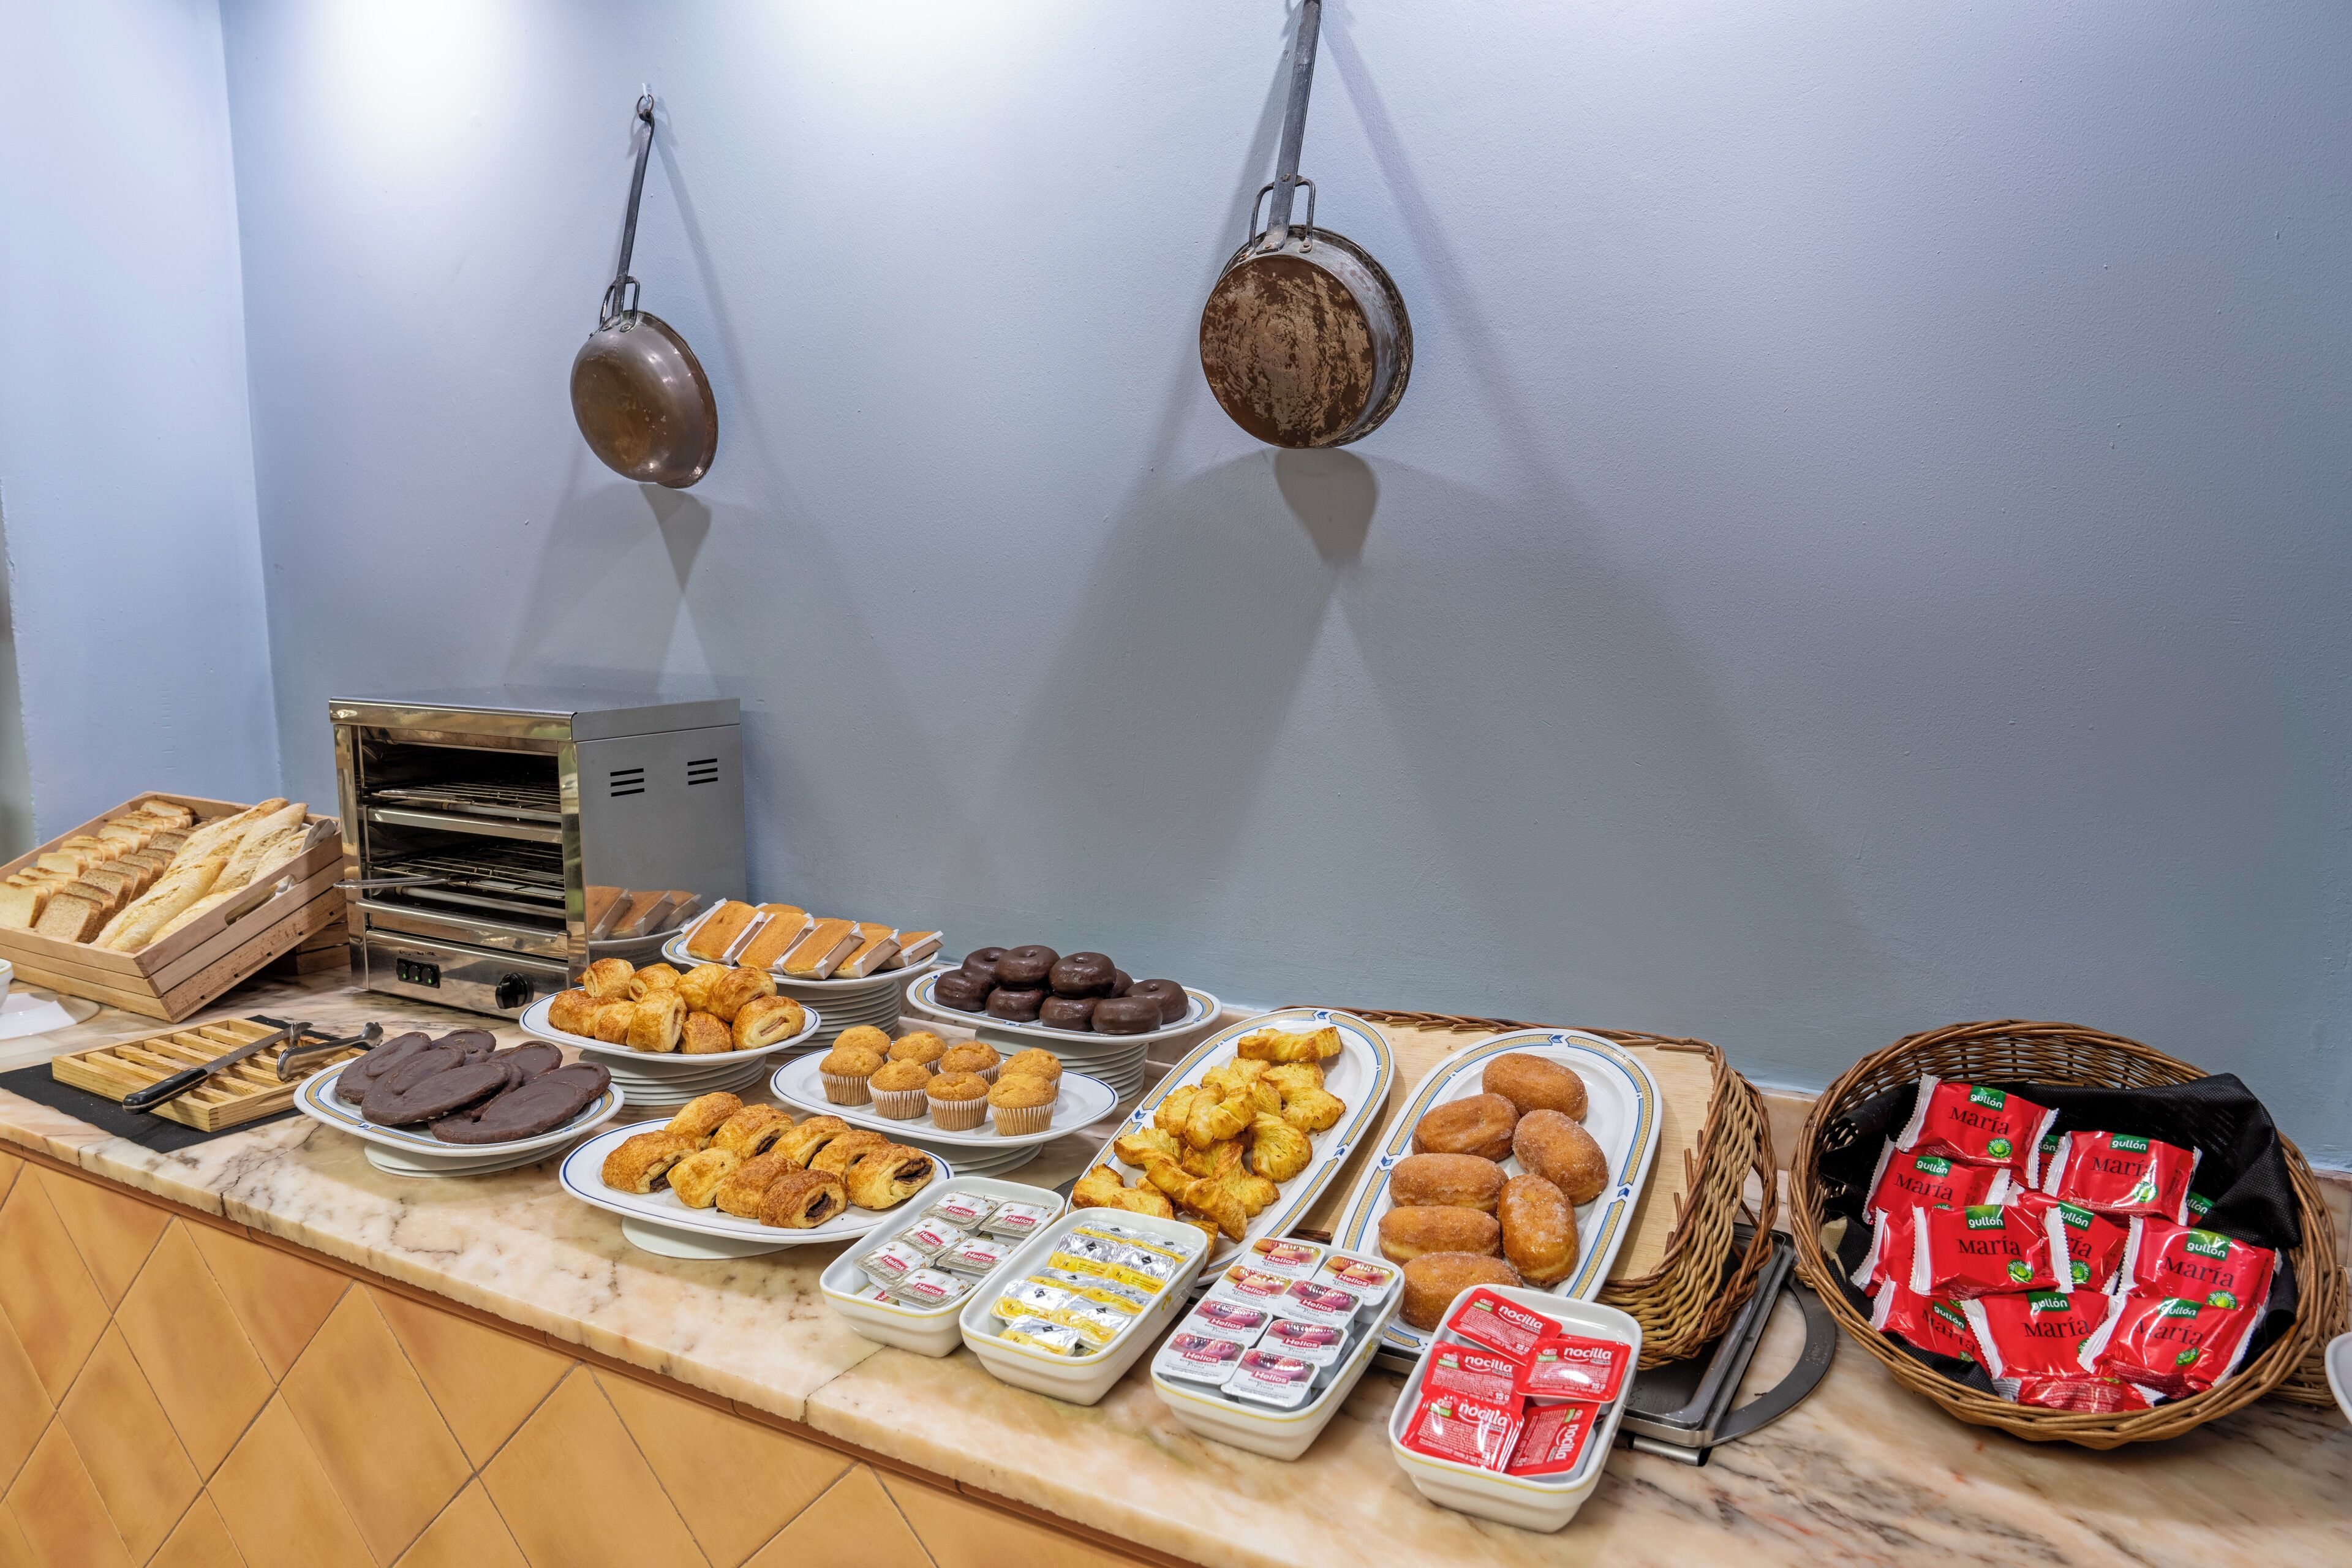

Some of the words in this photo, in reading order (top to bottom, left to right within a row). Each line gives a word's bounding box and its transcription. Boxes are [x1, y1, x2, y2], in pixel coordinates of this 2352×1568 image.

[1970, 1093, 2003, 1109] gullón
[1948, 1106, 2010, 1136] María
[2040, 1142, 2056, 1151] lón
[2112, 1140, 2147, 1150] gullón
[1917, 1160, 1948, 1175] gullón
[1894, 1173, 1953, 1201] María
[948, 1206, 973, 1216] Helios
[2187, 1199, 2208, 1214] llón
[1006, 1215, 1033, 1224] Helios
[1968, 1217, 2003, 1229] gullón
[2062, 1212, 2089, 1227] ullón
[919, 1231, 940, 1245] Helios
[1957, 1235, 2021, 1256] María
[2187, 1242, 2226, 1257] gullón
[883, 1256, 905, 1270] Helios
[967, 1252, 993, 1261] Helios
[1265, 1255, 1298, 1265] Helios
[2162, 1256, 2234, 1288] María
[1337, 1273, 1370, 1286] Helios
[916, 1284, 942, 1295] Helios
[1236, 1284, 1269, 1296] Helios
[1303, 1299, 1334, 1312] Helios
[2031, 1298, 2068, 1310] gullón
[1211, 1318, 1243, 1330] Helios
[1498, 1305, 1543, 1330] nocilla
[1934, 1306, 1965, 1329] gullón
[2022, 1317, 2090, 1338] María
[1286, 1338, 1318, 1348] Helios
[1186, 1352, 1219, 1363] Helios
[1564, 1348, 1612, 1360] nocilla
[1464, 1355, 1513, 1373] nocilla
[1255, 1371, 1288, 1383] Helios
[1458, 1403, 1507, 1427] nocilla
[1555, 1424, 1579, 1460] nocilla
